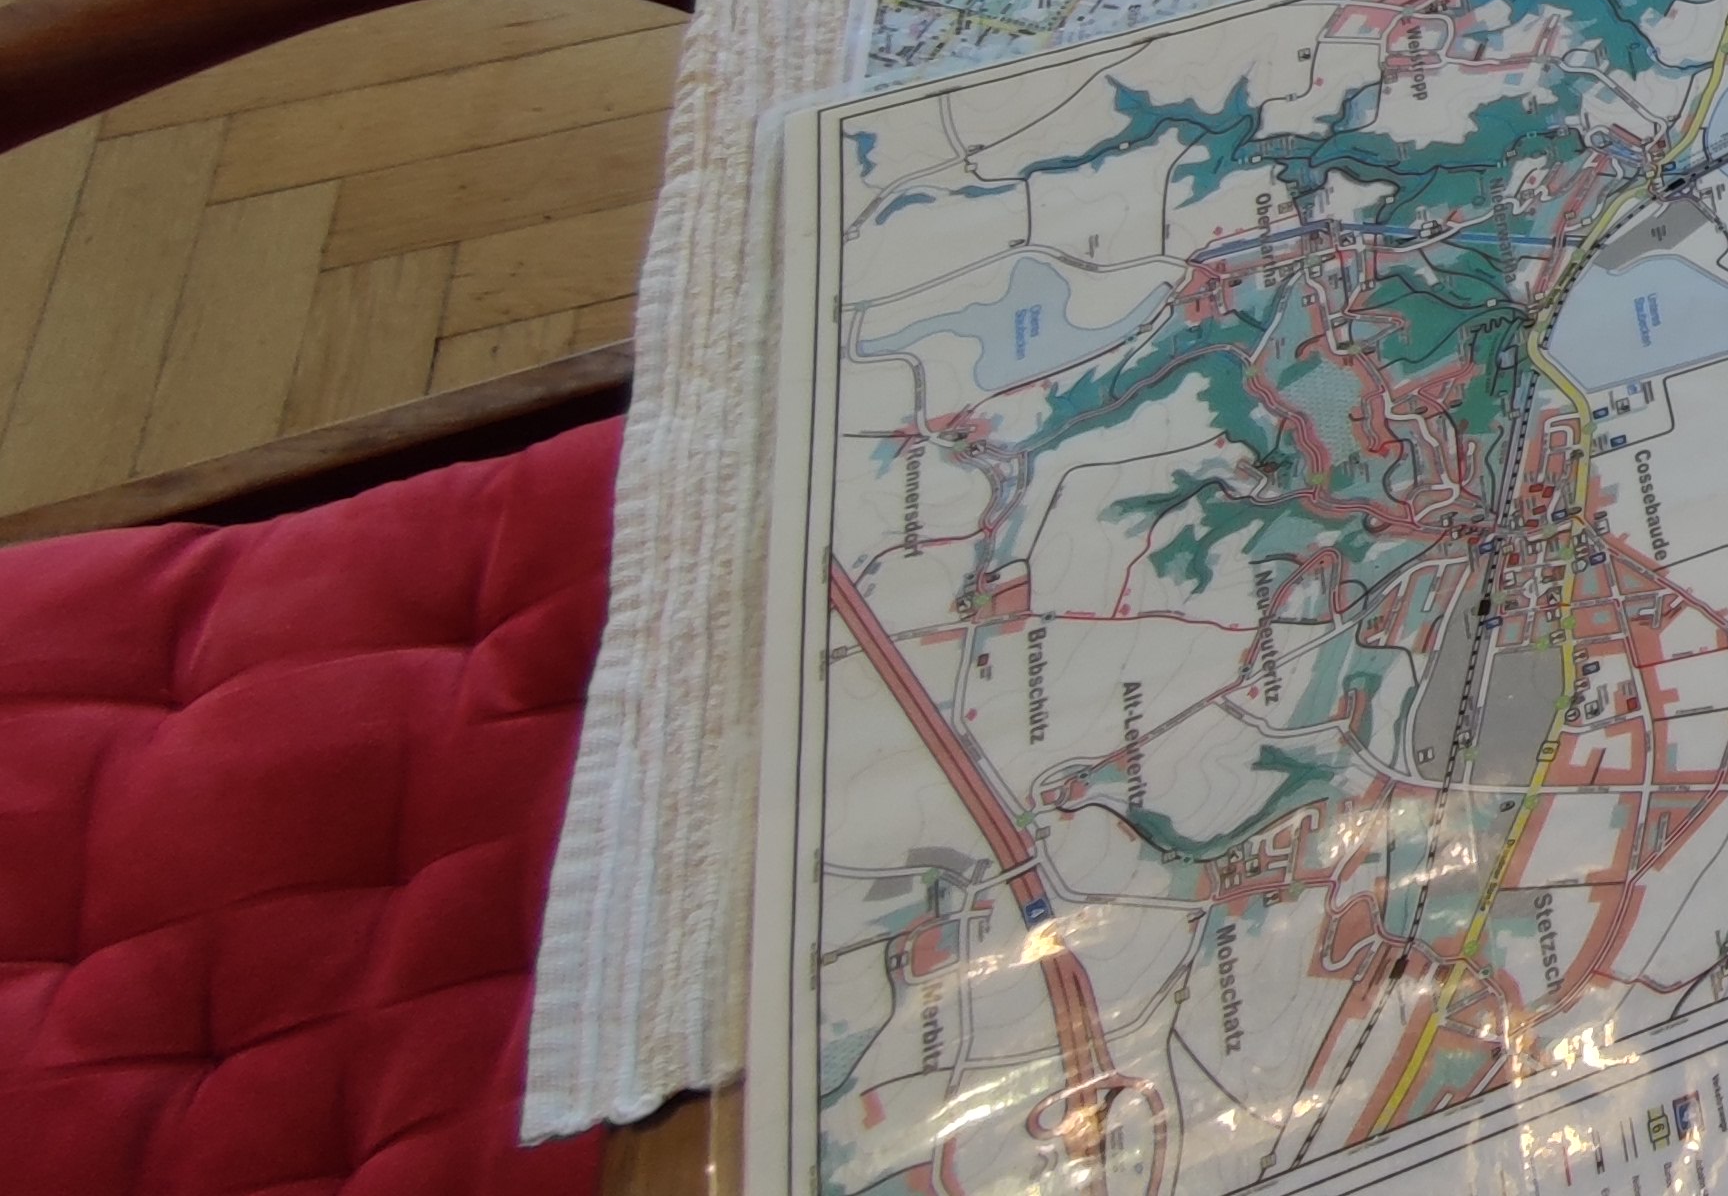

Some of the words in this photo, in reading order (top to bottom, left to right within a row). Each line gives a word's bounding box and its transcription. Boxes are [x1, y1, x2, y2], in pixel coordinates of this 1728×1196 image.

[1405, 25, 1430, 102] Weistropp
[903, 444, 925, 560] Rennersdorf
[1632, 447, 1672, 562] Cossebaude
[1025, 625, 1051, 746] Brabschütz
[1252, 568, 1284, 706] Neu-Leuteritz
[1121, 677, 1145, 812] Alt-Leuteritz
[1214, 922, 1246, 1057] Mobschatz
[1530, 891, 1567, 996] Stetzsch
[919, 980, 947, 1076] Merbitz
